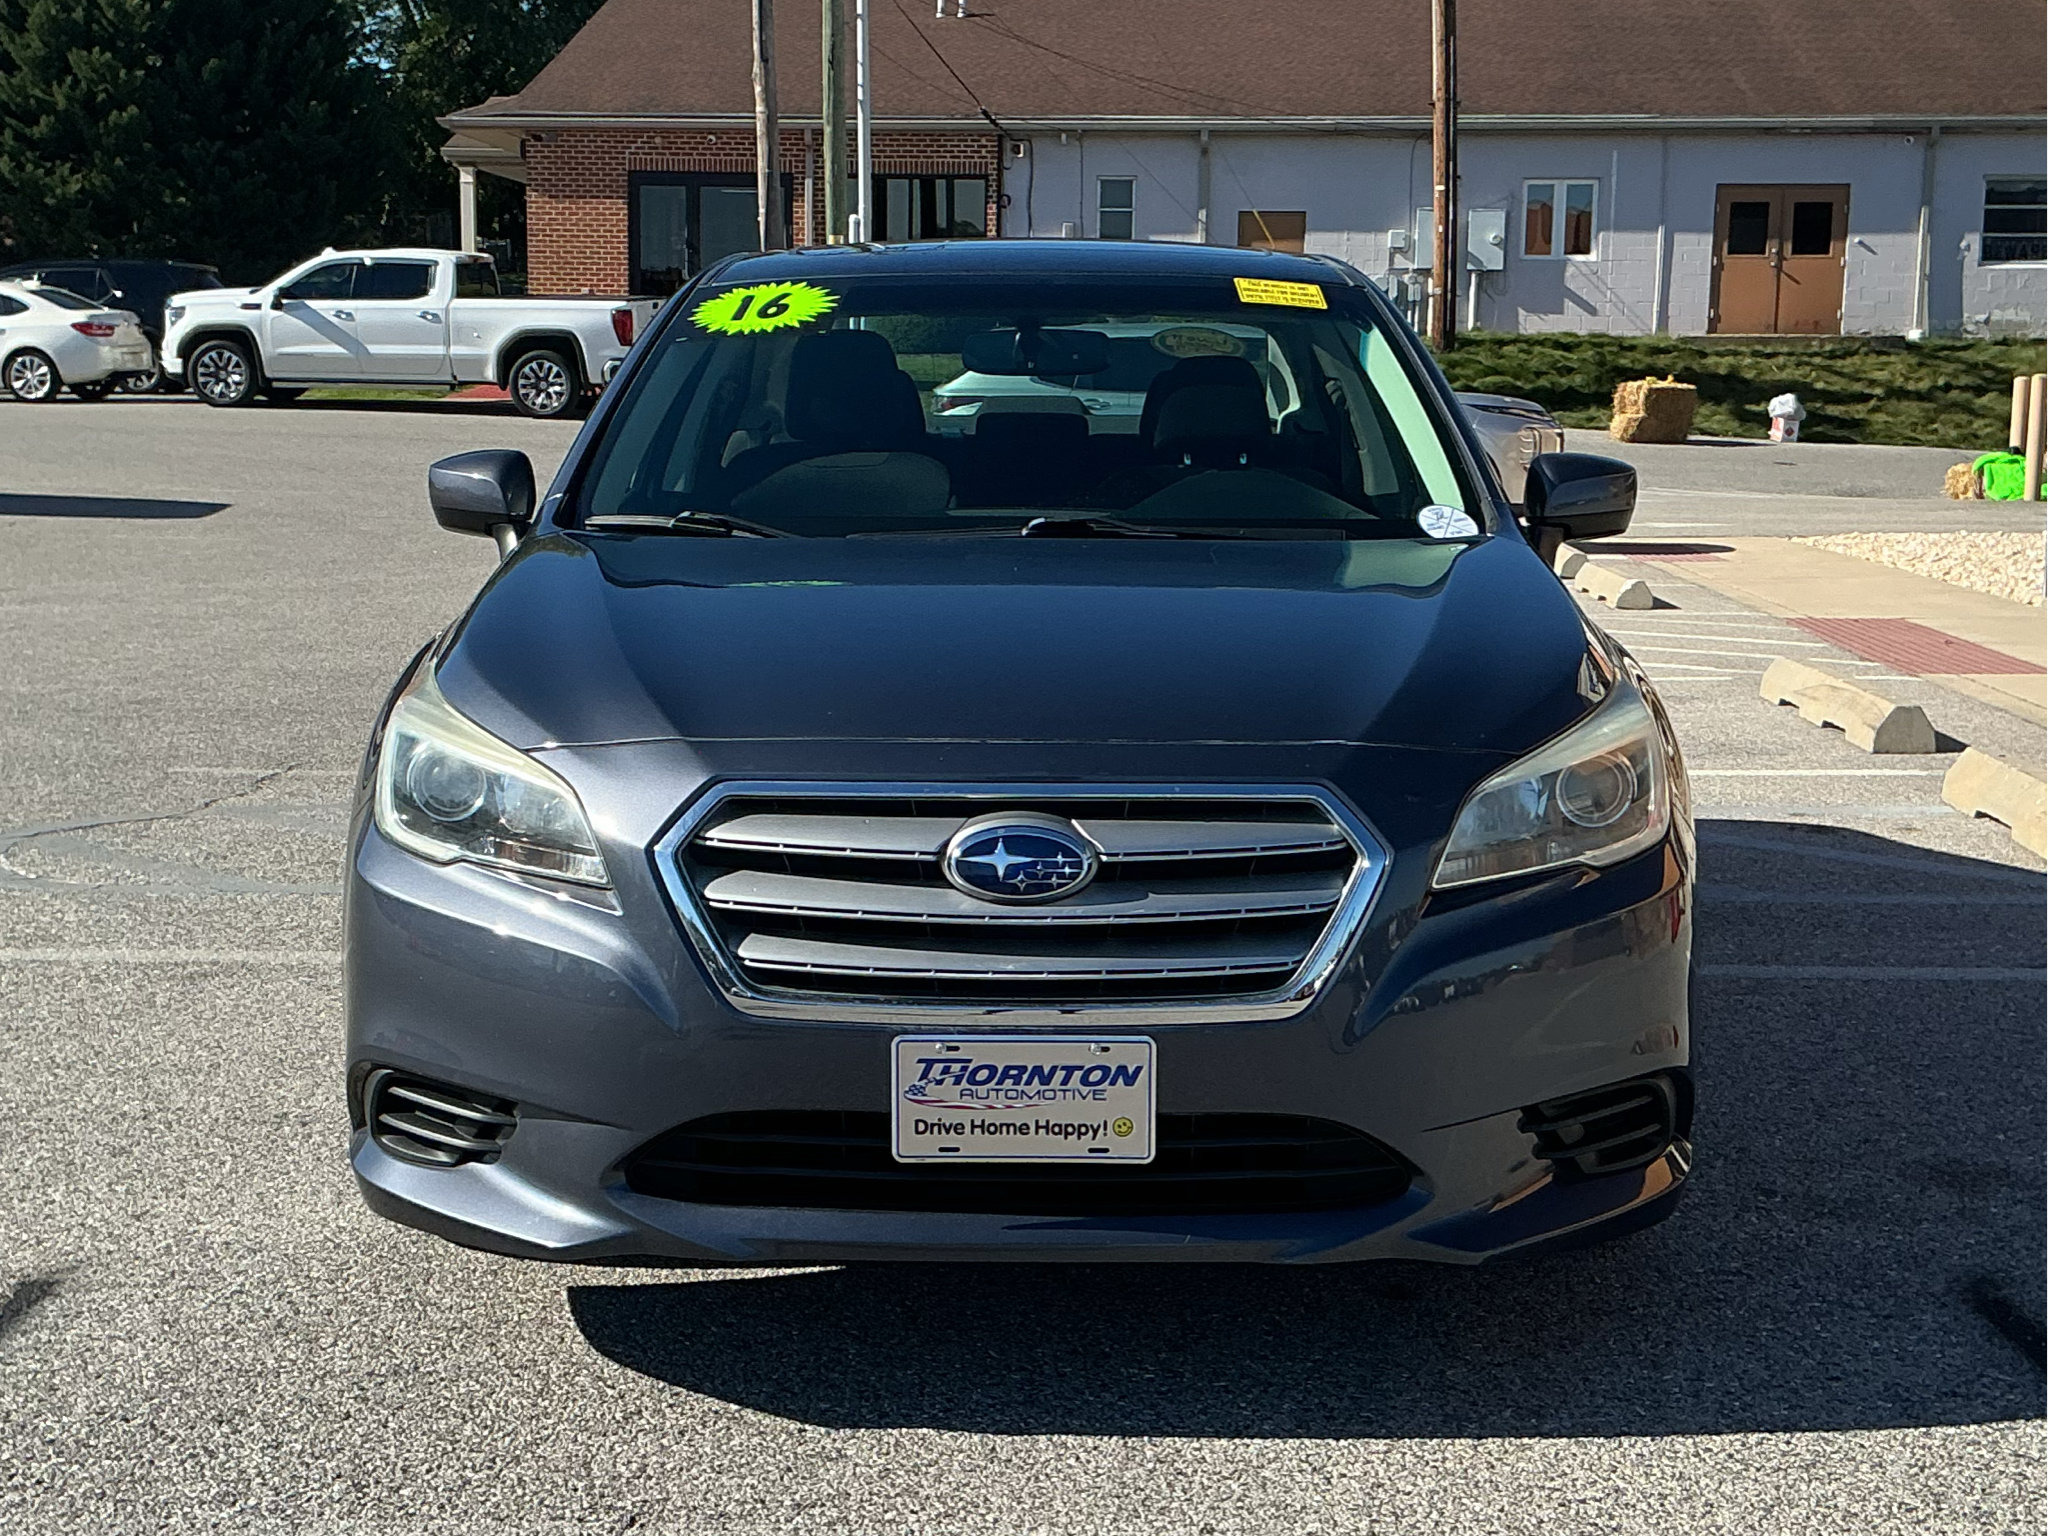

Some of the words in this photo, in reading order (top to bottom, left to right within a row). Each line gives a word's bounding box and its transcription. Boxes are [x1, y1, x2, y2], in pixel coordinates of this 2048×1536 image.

[730, 292, 793, 321] 16
[915, 1057, 1144, 1087] THORNTON
[959, 1088, 1107, 1101] AUTOMOTIVE
[914, 1117, 966, 1136] Drive
[970, 1118, 1030, 1136] Home
[1034, 1119, 1108, 1140] Happy!
